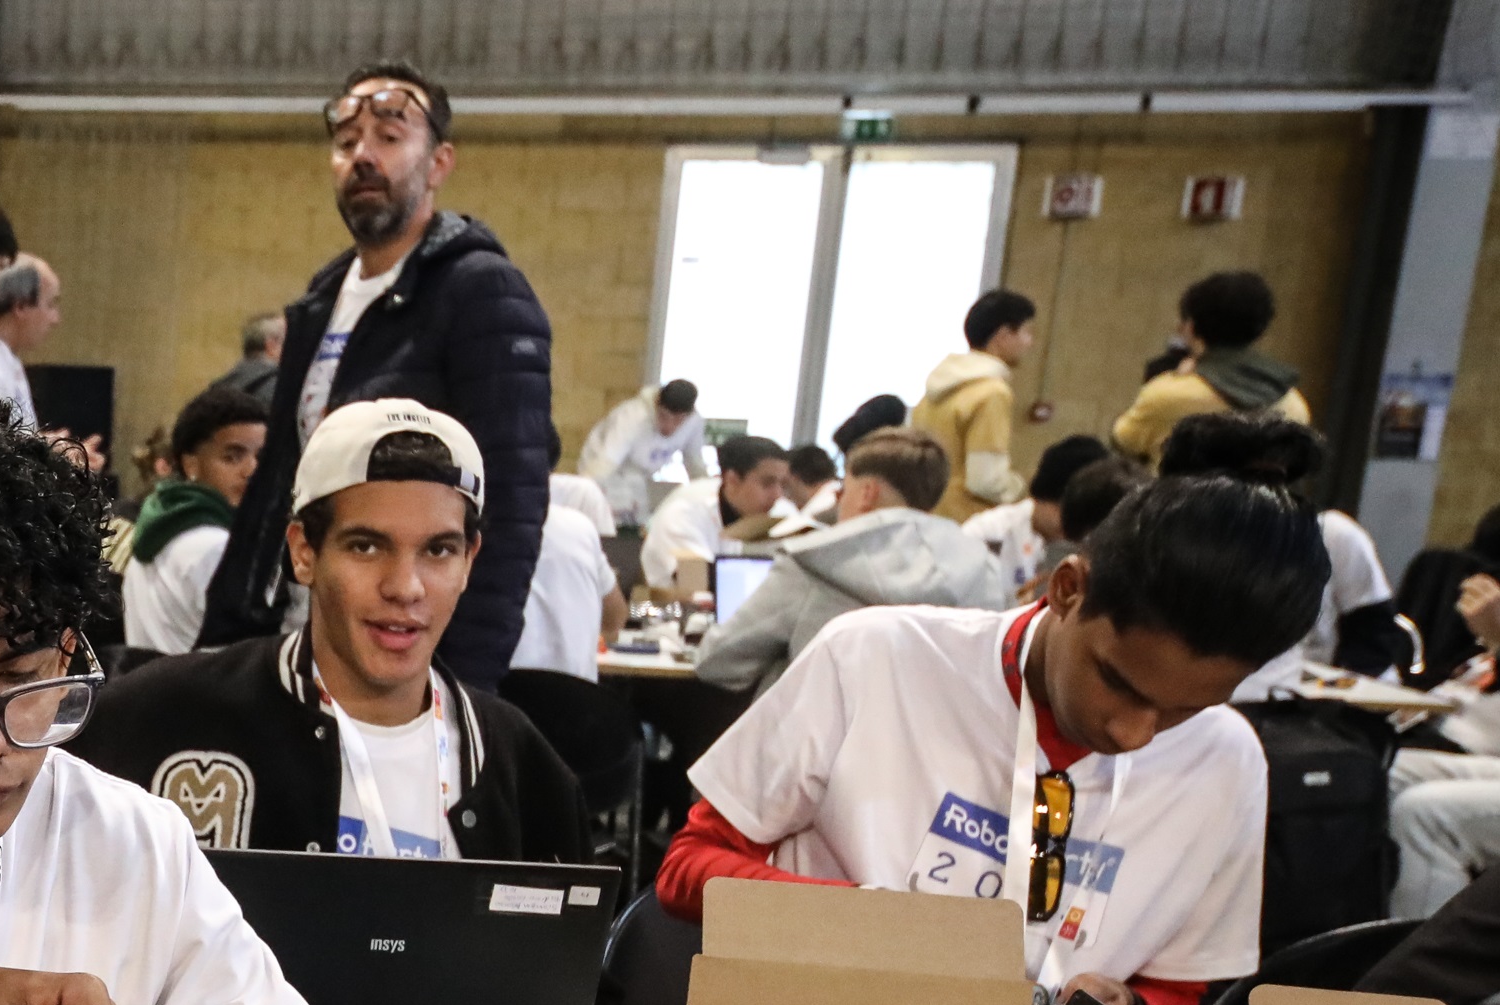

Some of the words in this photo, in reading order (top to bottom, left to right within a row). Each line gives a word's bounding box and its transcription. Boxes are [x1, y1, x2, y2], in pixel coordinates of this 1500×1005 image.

[403, 413, 431, 424] ANGELES
[928, 851, 956, 885] 2
[370, 938, 406, 954] insys
